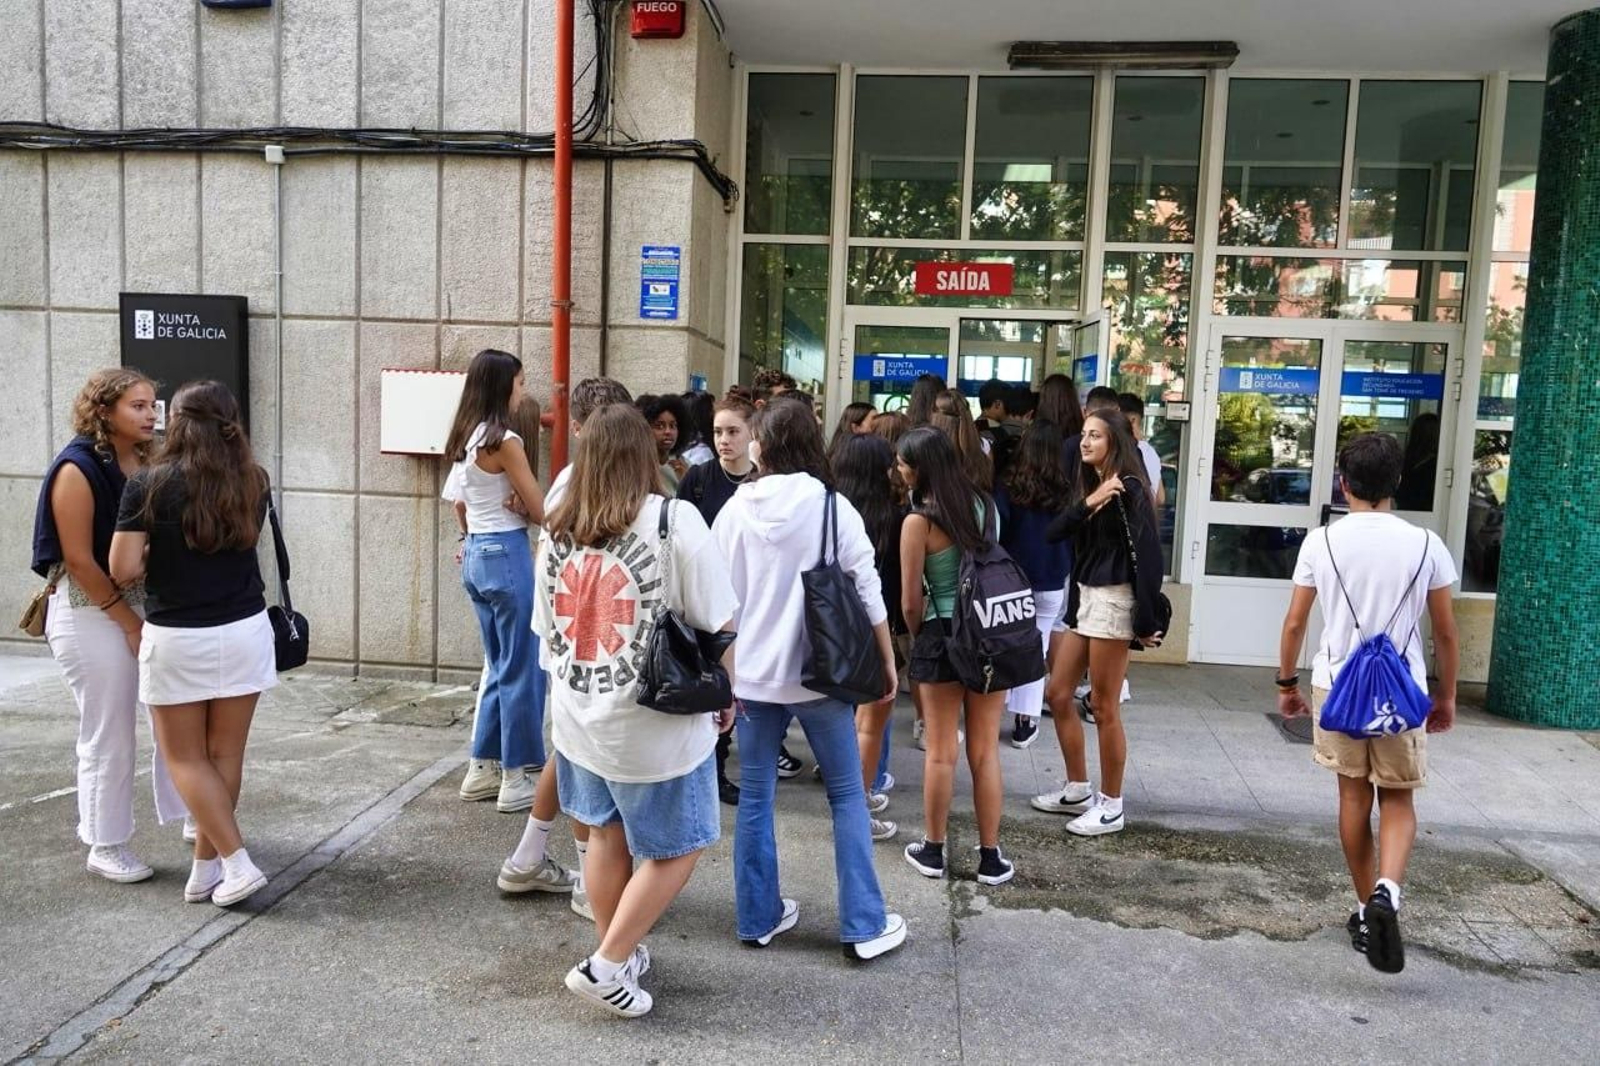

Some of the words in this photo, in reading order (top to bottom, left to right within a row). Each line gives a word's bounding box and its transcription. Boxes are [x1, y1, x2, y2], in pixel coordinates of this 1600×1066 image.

[637, 2, 677, 12] FUEGO
[936, 266, 991, 291] SAÍDA
[158, 313, 200, 325] XUNTA
[158, 326, 174, 338] DE
[177, 327, 226, 339] GALICIA
[1254, 380, 1265, 388] DE
[1266, 381, 1300, 389] GALICIA
[973, 588, 1036, 629] VANS
